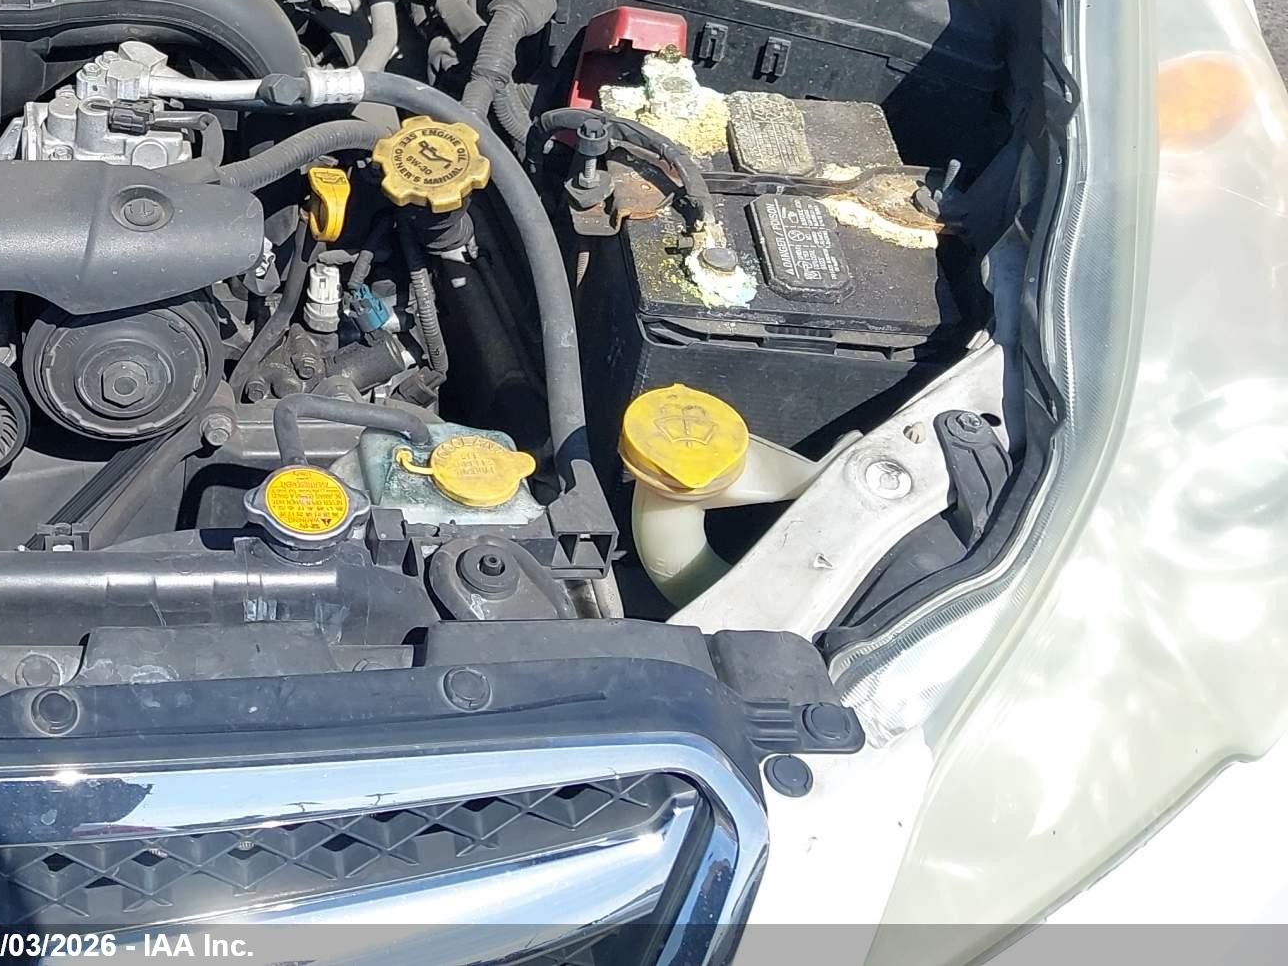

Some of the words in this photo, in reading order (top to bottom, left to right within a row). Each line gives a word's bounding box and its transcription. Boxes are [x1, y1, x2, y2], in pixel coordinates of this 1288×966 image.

[399, 132, 418, 147] SEE
[421, 129, 461, 146] ENGINE
[456, 147, 467, 163] OIL
[394, 148, 421, 183] OWNER'S
[405, 155, 433, 175] 5W-30
[423, 167, 463, 185] MANUAL
[766, 203, 782, 231] POISON
[775, 237, 794, 268] DANGER
